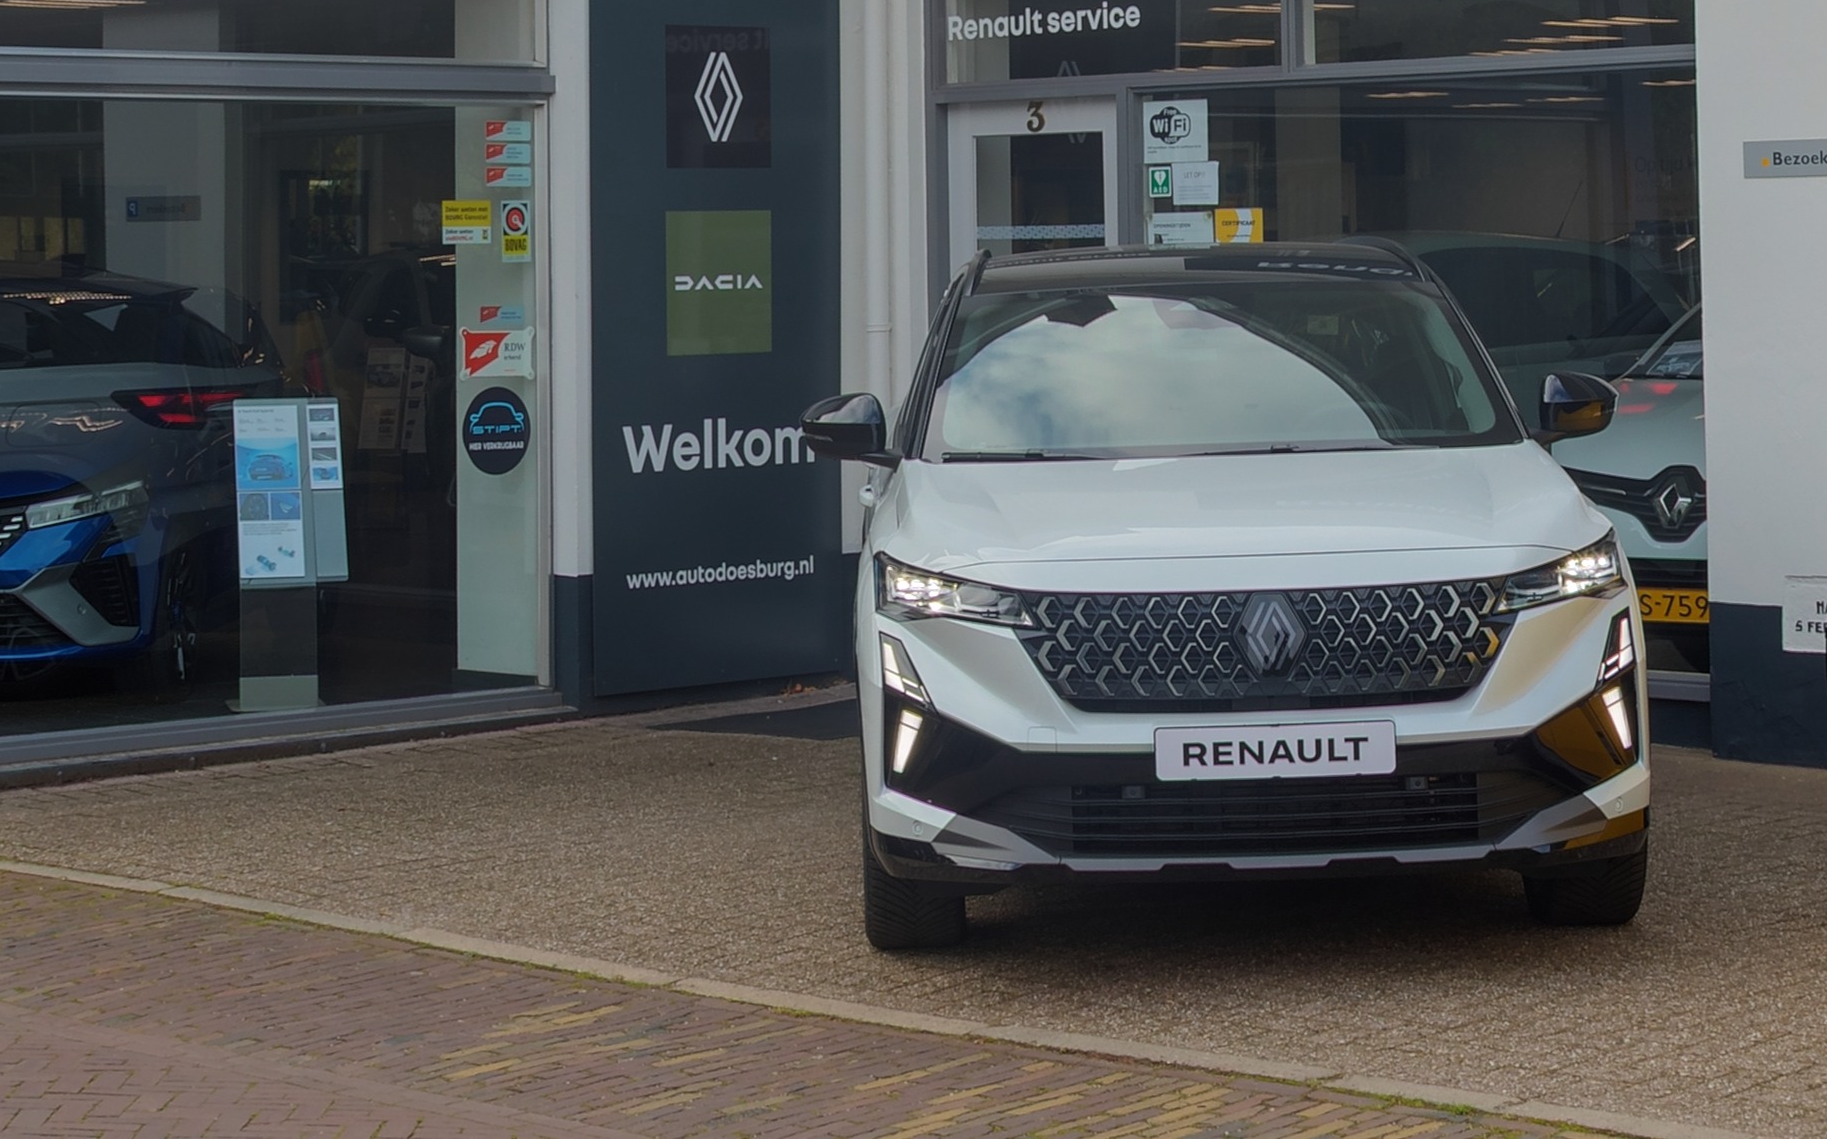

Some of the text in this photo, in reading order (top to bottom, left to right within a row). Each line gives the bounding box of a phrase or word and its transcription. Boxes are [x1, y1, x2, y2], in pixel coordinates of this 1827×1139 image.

[946, 1, 1141, 42] Renault service
[1026, 100, 1046, 133] 3
[1153, 186, 1169, 194] AED
[505, 238, 527, 252] BOVAG
[674, 274, 763, 291] DACIA
[504, 342, 525, 352] RDW
[622, 417, 815, 474] Welkom
[626, 554, 814, 590] www.autodoesburg.nl
[1640, 593, 1708, 618] S-759
[1182, 736, 1369, 767] RENAULT
